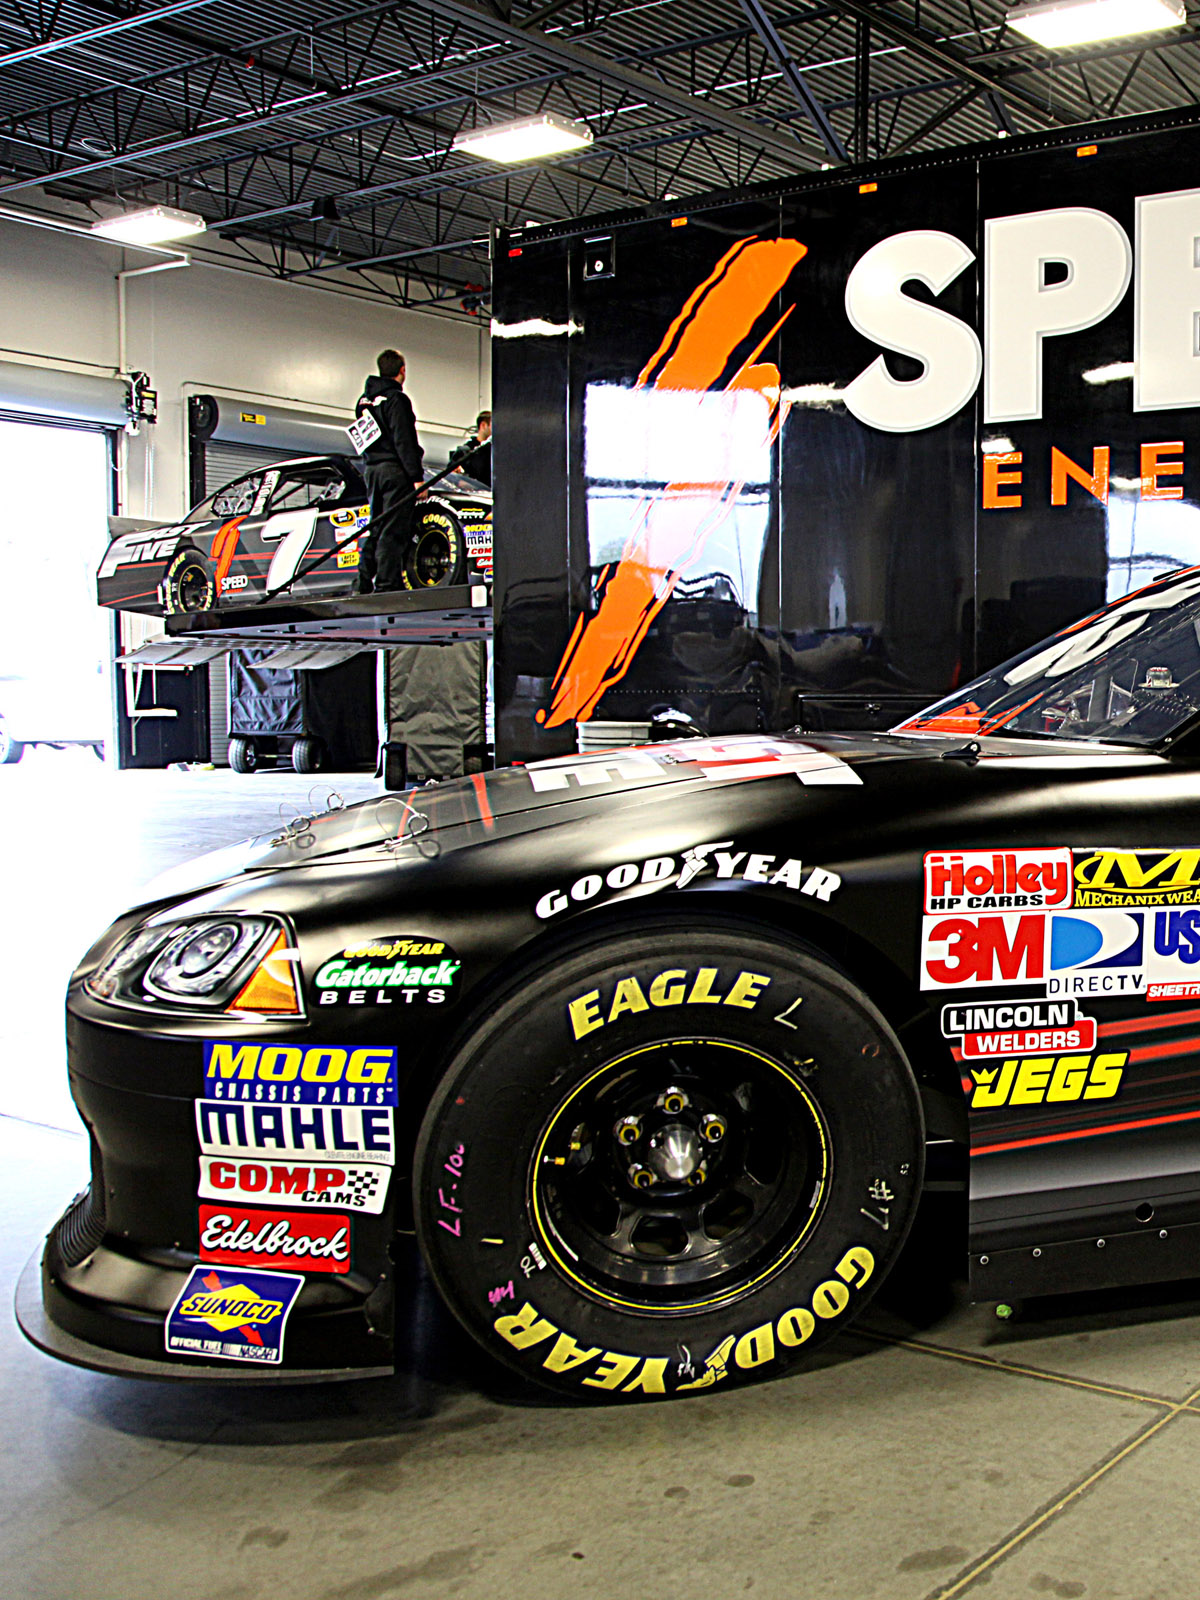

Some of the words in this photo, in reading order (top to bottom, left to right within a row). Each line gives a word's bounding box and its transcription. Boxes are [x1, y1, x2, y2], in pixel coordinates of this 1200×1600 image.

[261, 508, 319, 595] 7
[467, 536, 492, 545] MAH
[471, 547, 492, 555] COM
[221, 575, 248, 590] SPEED
[930, 854, 1068, 905] Holley
[931, 898, 961, 910] HP
[967, 894, 1043, 909] CARBS
[1074, 887, 1165, 907] MECHANIX
[926, 914, 1045, 985] 3M
[315, 959, 460, 988] Gatorback
[1049, 974, 1144, 994] DIRECTV
[319, 988, 446, 1005] BELTS
[567, 967, 772, 1041] EAGLE
[950, 1004, 1069, 1032] LINCOLN
[976, 1030, 1081, 1053] WELDERS
[206, 1043, 394, 1084] MOOG
[214, 1082, 302, 1102] CHASSIS
[317, 1086, 385, 1104] PARTS
[971, 1052, 1128, 1108] JEGS
[199, 1101, 391, 1152] MAHLE
[209, 1161, 346, 1195] COMP
[301, 1190, 367, 1207] CAMS
[200, 1214, 349, 1261] Edelbrock
[184, 1296, 278, 1321] SUNOCO
